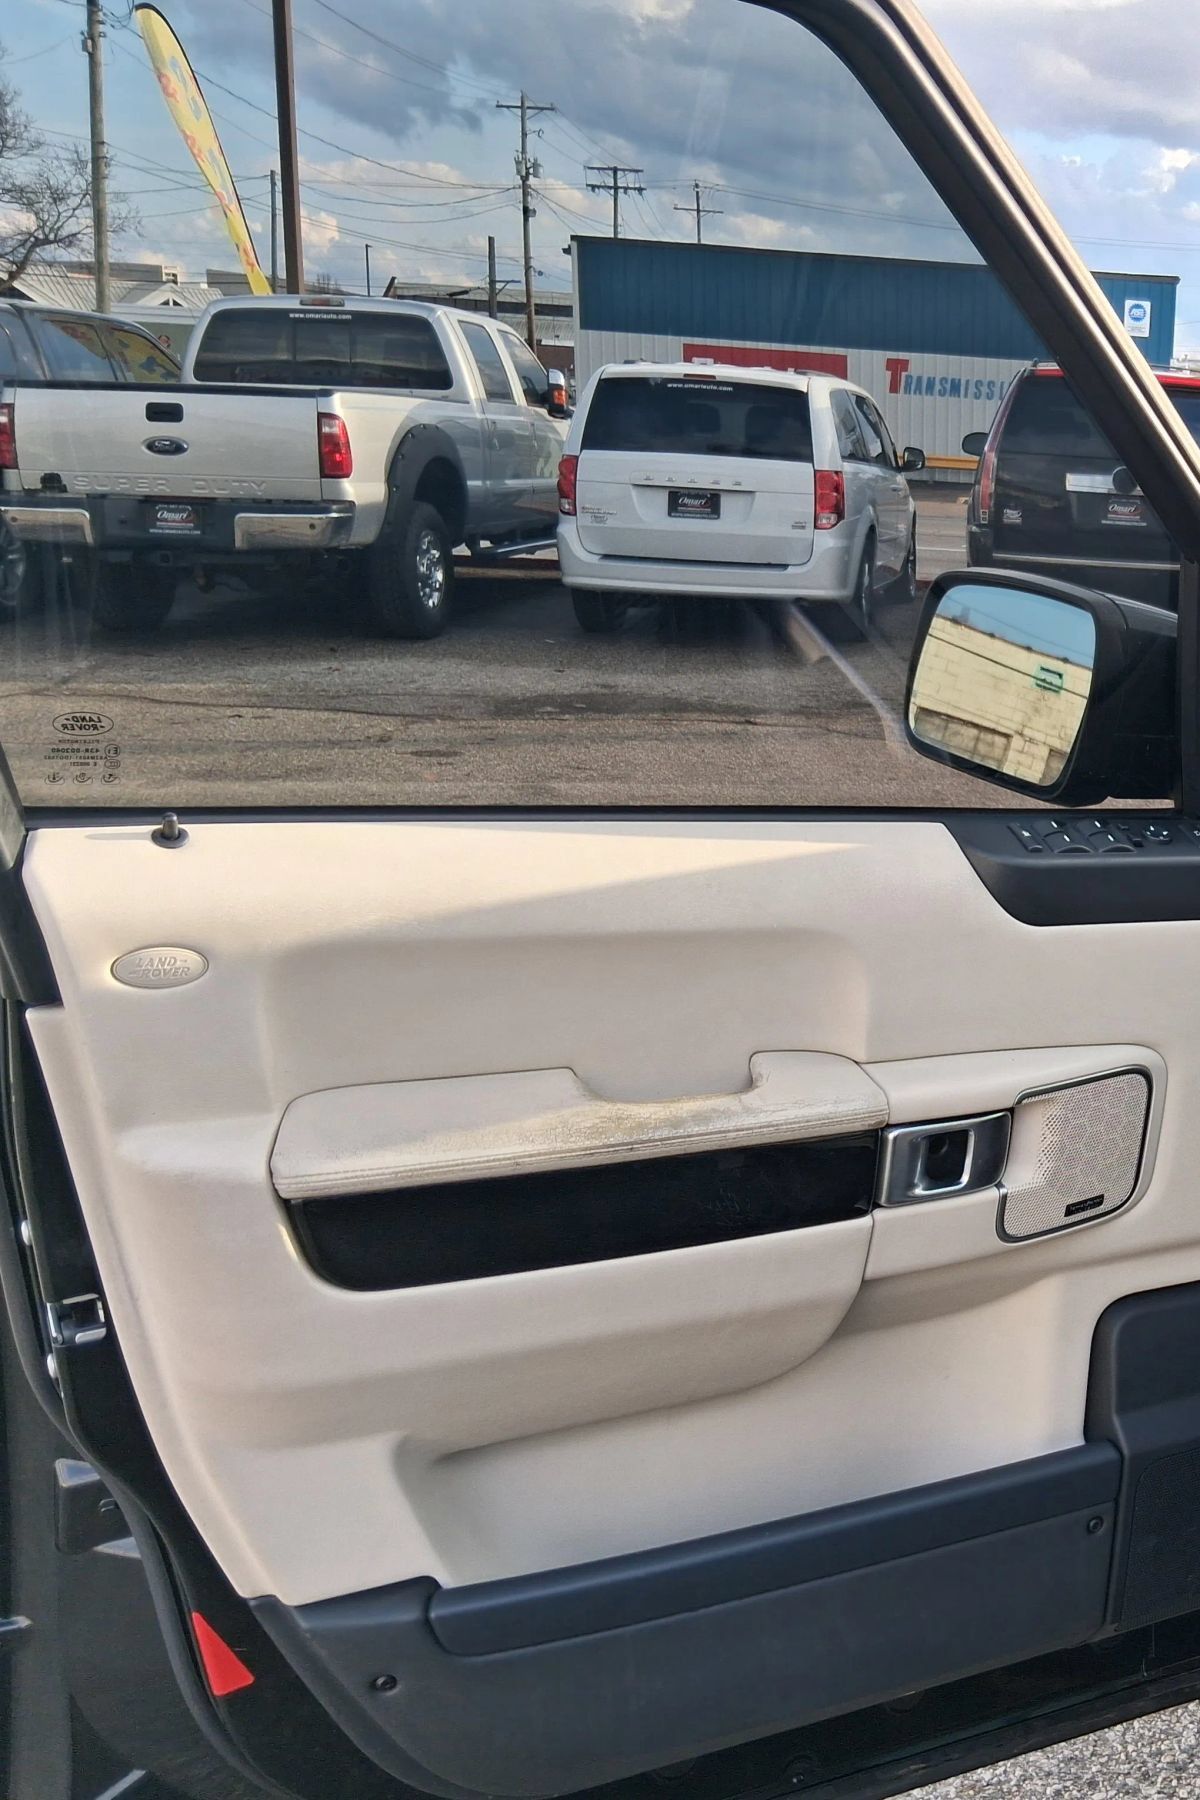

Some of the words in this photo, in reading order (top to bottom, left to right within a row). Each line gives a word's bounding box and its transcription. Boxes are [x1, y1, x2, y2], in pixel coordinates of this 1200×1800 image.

[73, 475, 171, 493] SUPER
[192, 478, 267, 496] DUTY
[134, 956, 178, 968] LAND
[139, 966, 191, 979] ROVER
